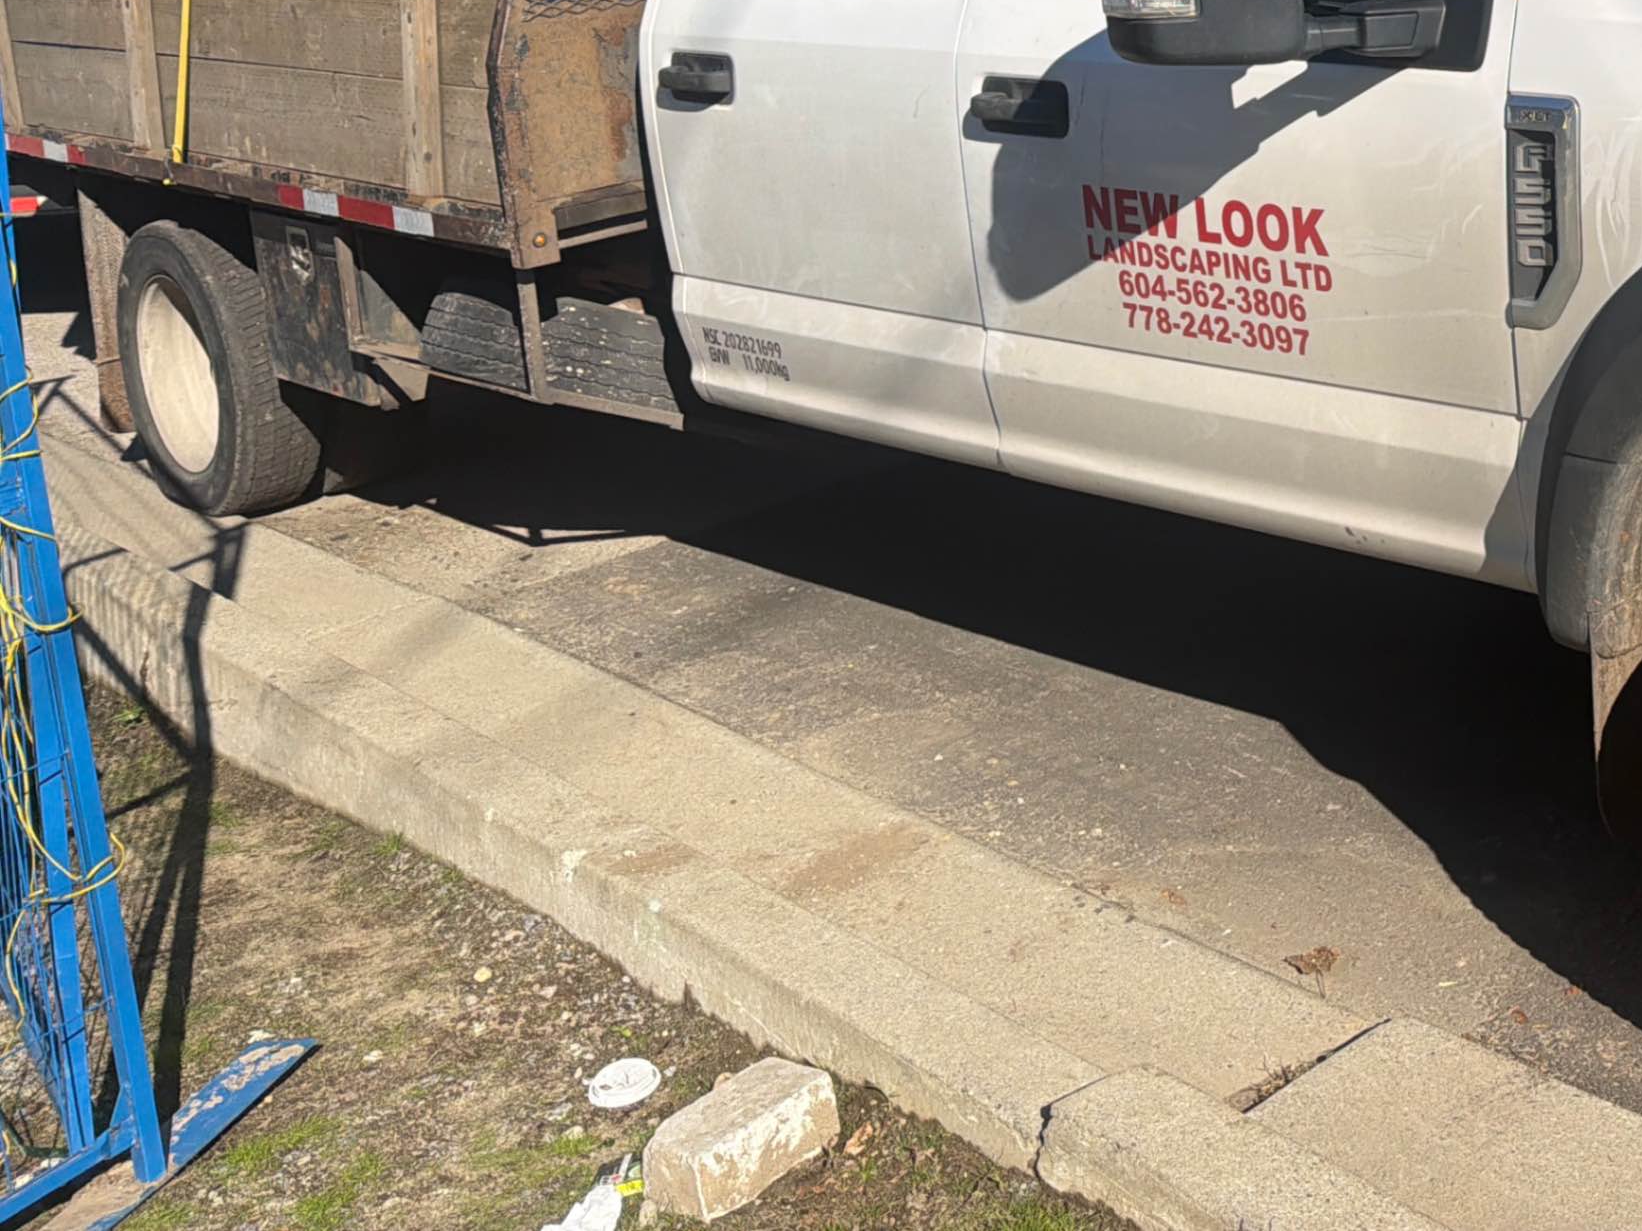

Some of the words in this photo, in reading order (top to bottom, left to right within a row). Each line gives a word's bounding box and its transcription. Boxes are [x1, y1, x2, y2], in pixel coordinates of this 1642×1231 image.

[1082, 184, 1179, 239] NEW
[1195, 197, 1329, 257] LOOK
[1087, 235, 1272, 284] LANDSCAPING
[1280, 259, 1333, 292] LTD
[1118, 270, 1307, 322] 604-562-3806
[1122, 302, 1310, 355] 778-242-3097
